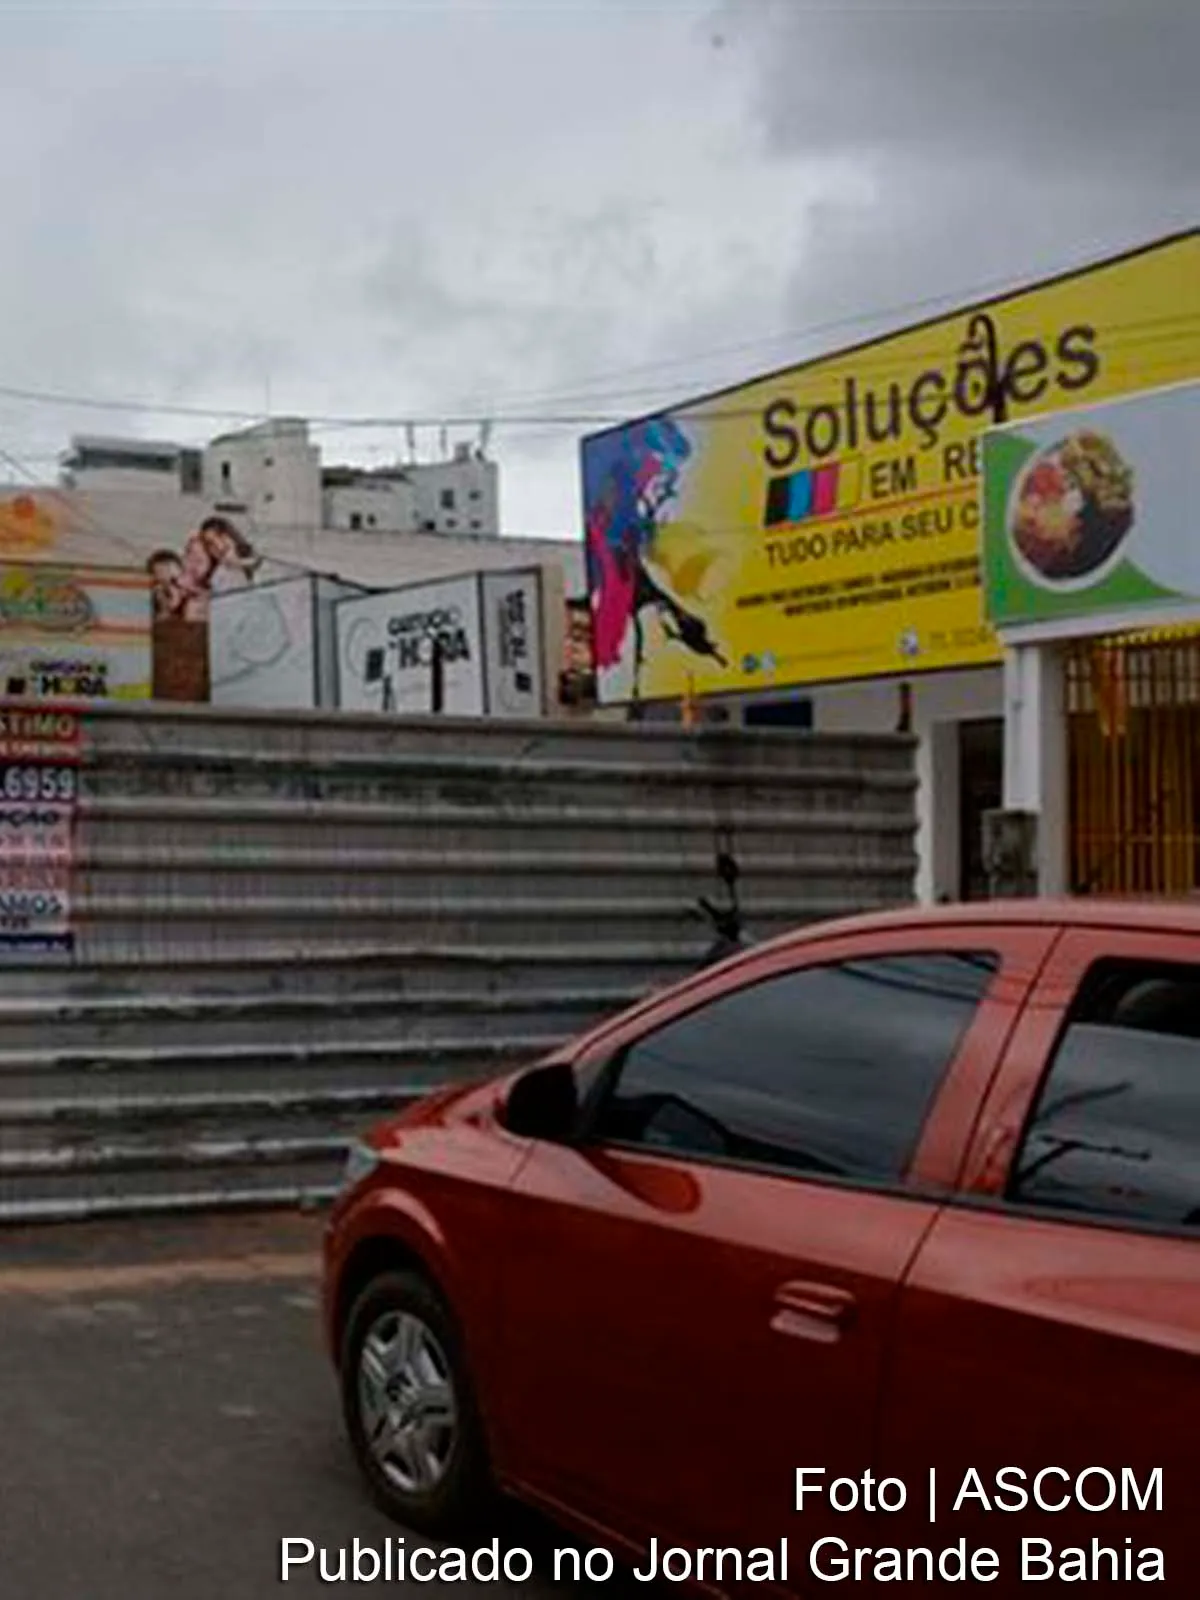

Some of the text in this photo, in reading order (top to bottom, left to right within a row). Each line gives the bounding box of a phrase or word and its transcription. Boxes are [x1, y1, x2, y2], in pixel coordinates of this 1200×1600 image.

[870, 456, 917, 499] EM
[764, 533, 827, 569] TUDO
[831, 519, 897, 555] PARA
[901, 504, 952, 541] SEU
